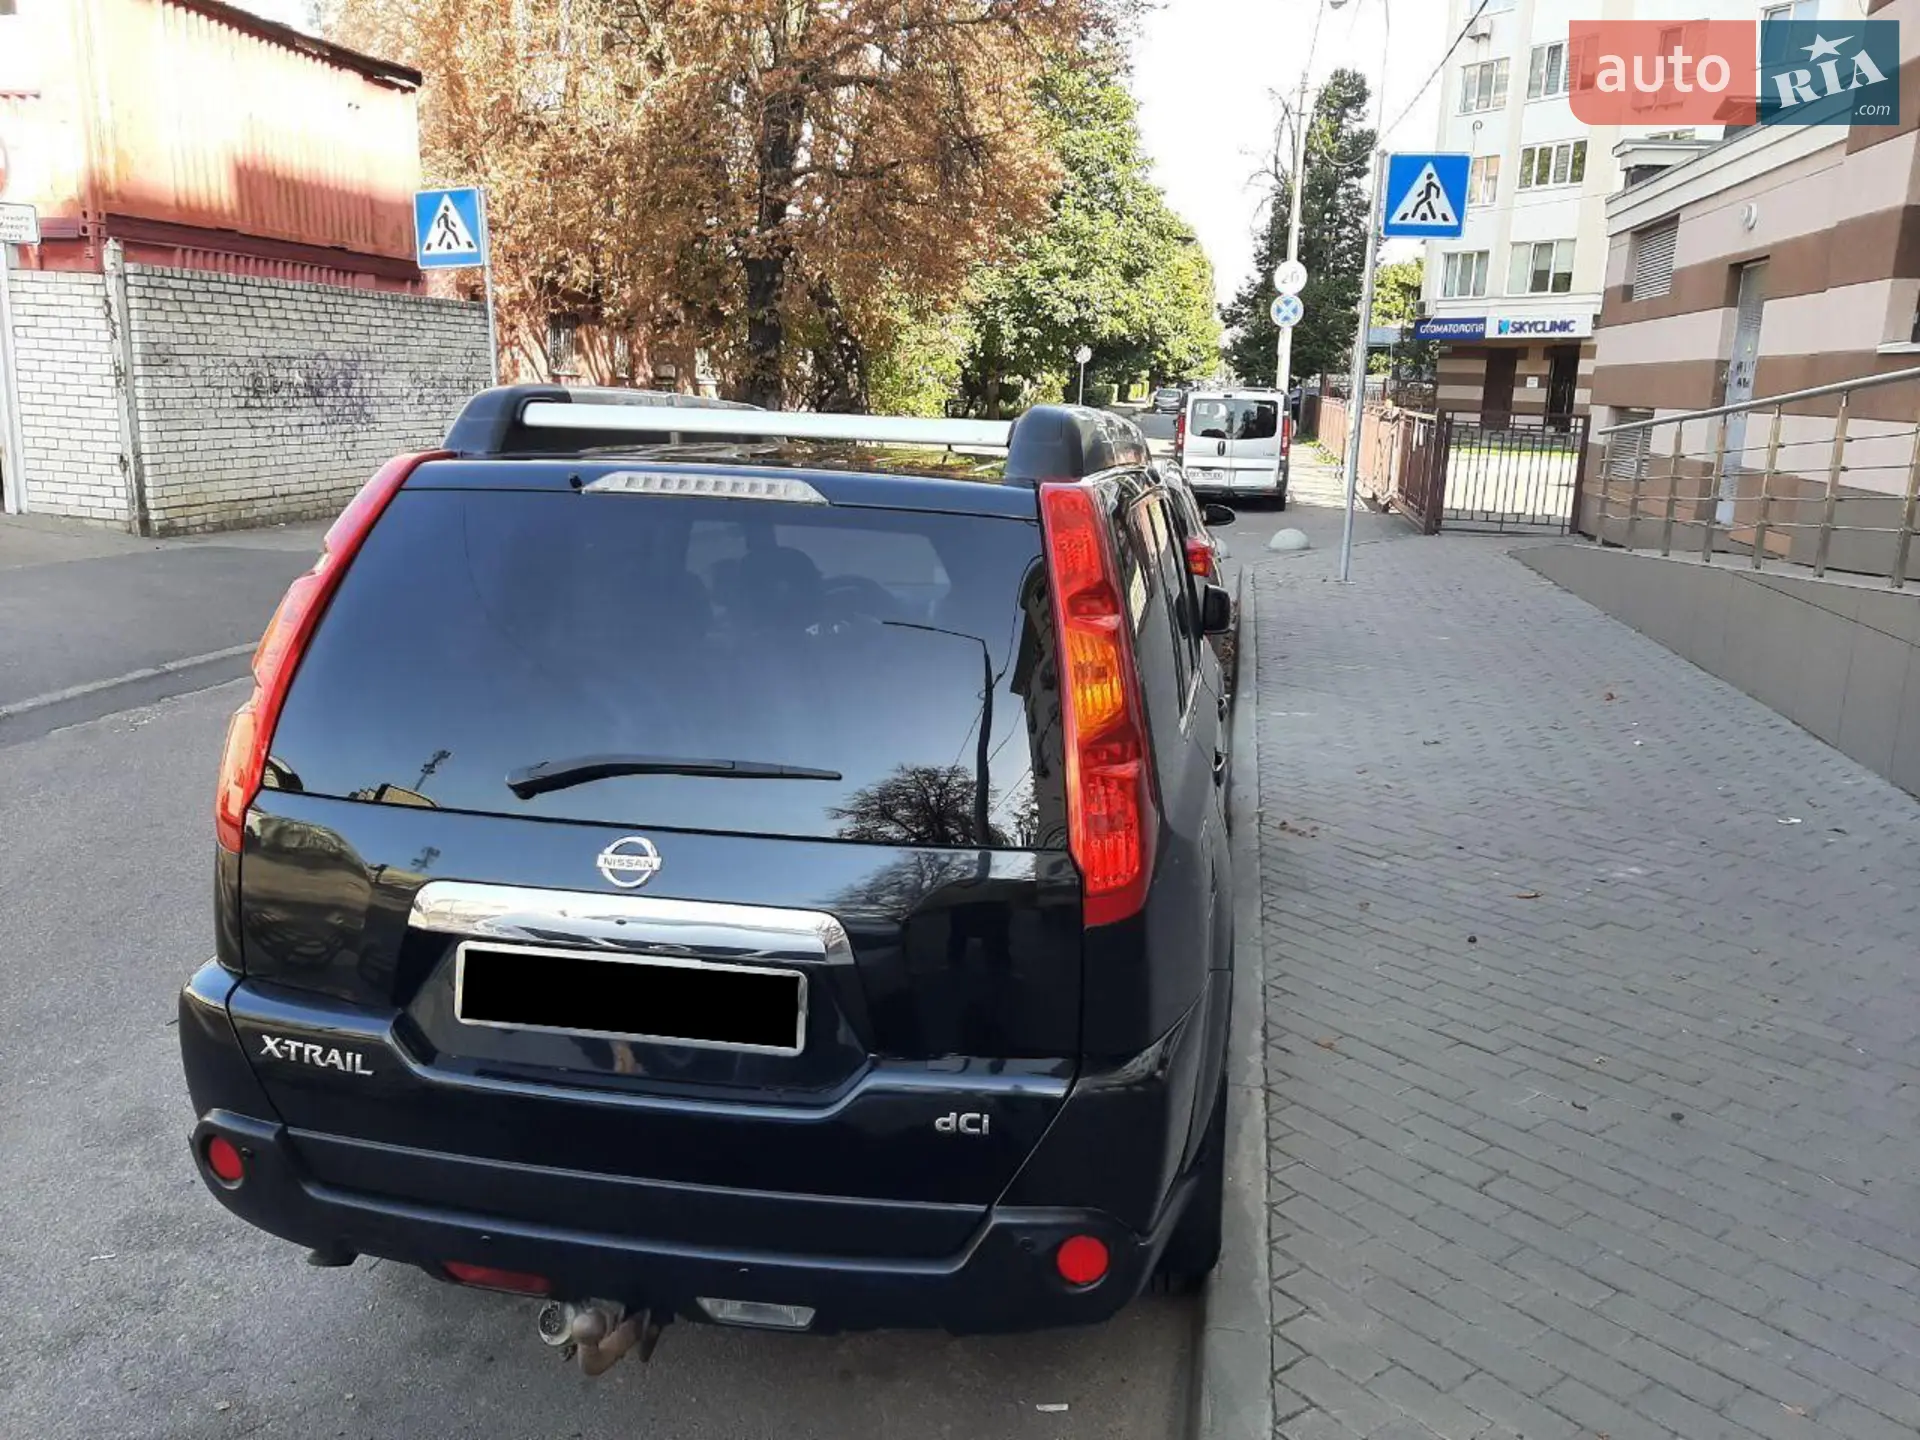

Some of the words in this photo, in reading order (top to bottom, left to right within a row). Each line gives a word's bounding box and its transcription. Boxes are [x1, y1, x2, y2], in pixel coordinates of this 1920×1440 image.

[1510, 319, 1577, 334] SKYCLINIC
[603, 856, 654, 869] NISSAN
[260, 1034, 374, 1076] X-TRAIL
